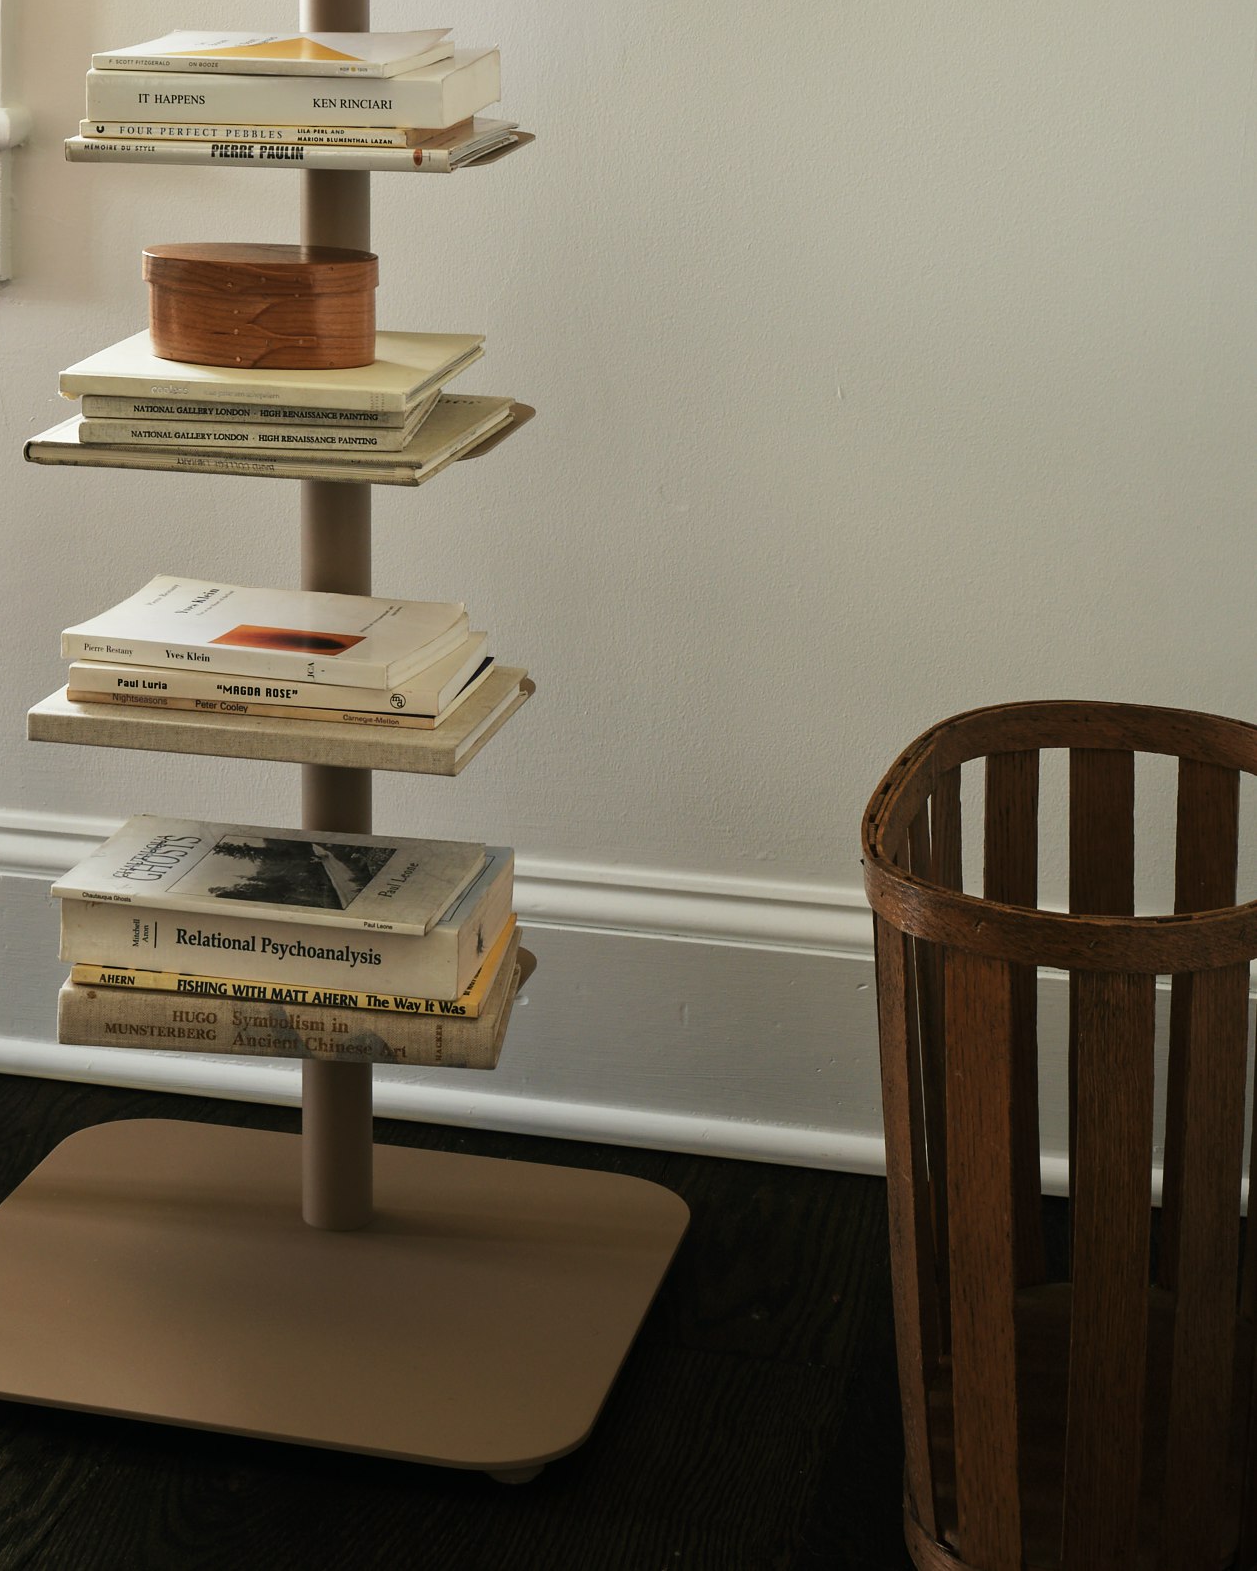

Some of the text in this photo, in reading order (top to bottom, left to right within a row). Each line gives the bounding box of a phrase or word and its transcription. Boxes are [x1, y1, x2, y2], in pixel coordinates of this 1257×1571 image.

[138, 94, 206, 105] IT HAPPENS
[313, 98, 392, 110] KEN RINCIARI
[119, 126, 283, 139] FOUR PERFECT PEBBLES
[84, 143, 117, 151] MÉMOIRE
[211, 144, 304, 160] PIERRE PAULIN
[133, 405, 174, 414] NATIONAL
[176, 407, 214, 415] GALLERY
[216, 408, 250, 416] LONDON
[283, 411, 338, 419] RENAISSANCE
[340, 412, 378, 420] PAINTING
[174, 432, 212, 440] GALLERY
[214, 433, 248, 441] LONDON
[281, 435, 336, 443] RENAISSANCE
[338, 437, 377, 445] PAINTING
[192, 588, 220, 603] Klein
[84, 643, 133, 657] Pierre Restany
[166, 650, 210, 662] Yves Klein
[118, 678, 168, 690] Paul Luria
[112, 693, 168, 705] Nightseasons
[195, 700, 248, 713] Peter Cooley
[342, 714, 399, 725] Carnegie-Mellon
[126, 836, 201, 881] GHOSTS
[378, 862, 419, 898] Paul Leone
[82, 892, 113, 901] Chautauqua
[176, 928, 382, 967] Relational Psychoanalysis
[99, 974, 135, 985] AHERN
[177, 979, 465, 1015] FISHING WITH MATT AHERN The Way It Was
[172, 1010, 218, 1024] HUGO
[232, 1010, 349, 1034] Symbolism in
[105, 1022, 217, 1040] MUNSTERBERG
[233, 1033, 407, 1058] Ancient Chinese Art
